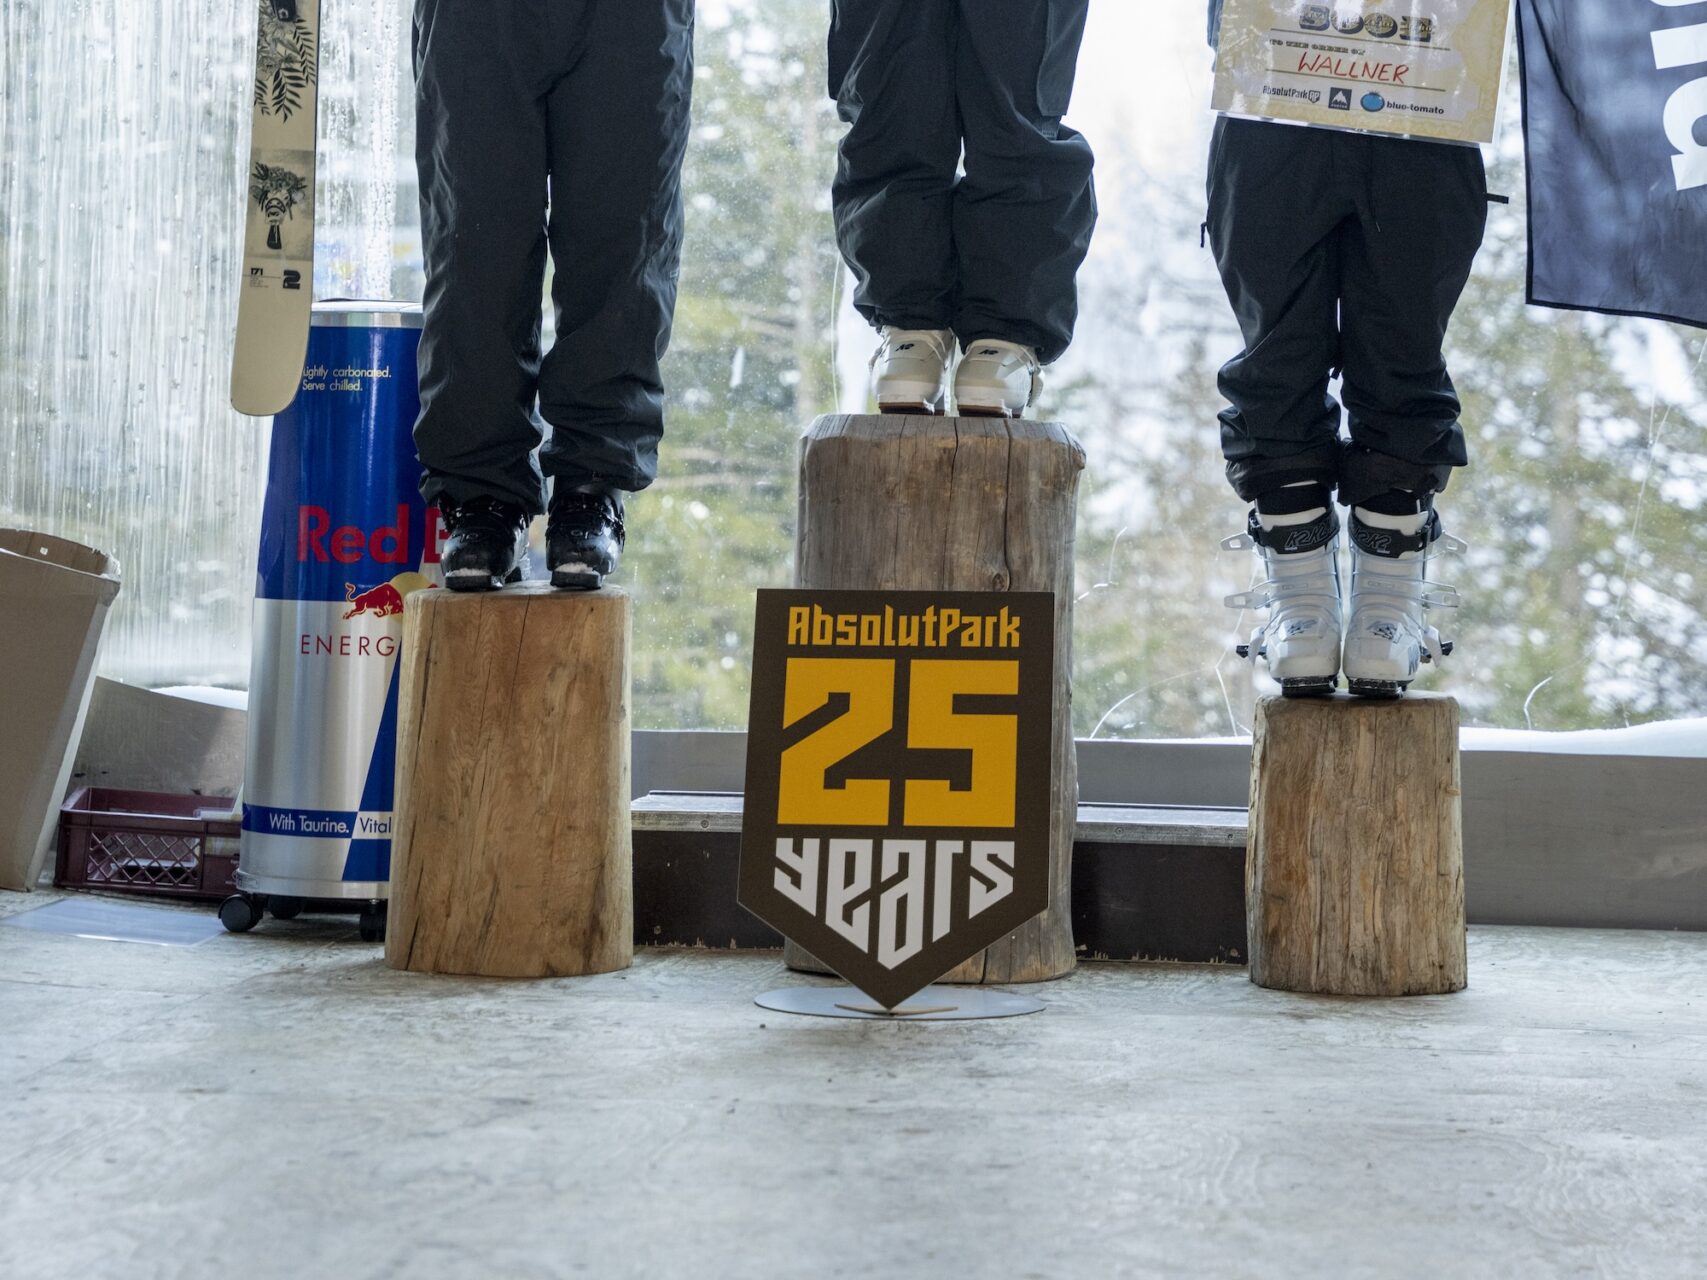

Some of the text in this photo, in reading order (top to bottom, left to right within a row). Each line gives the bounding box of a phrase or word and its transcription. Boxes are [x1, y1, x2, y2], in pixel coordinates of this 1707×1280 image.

[1297, 52, 1409, 84] WALLNER
[1386, 101, 1445, 115] blue-tomato
[302, 379, 363, 392] Serve chilled.
[332, 365, 392, 378] carbonated.
[297, 504, 410, 564] Red
[787, 603, 1021, 648] AbsolutPark
[777, 657, 1020, 828] 25
[269, 812, 296, 831] With
[299, 815, 350, 834] Taurine.
[773, 837, 1015, 971] years
